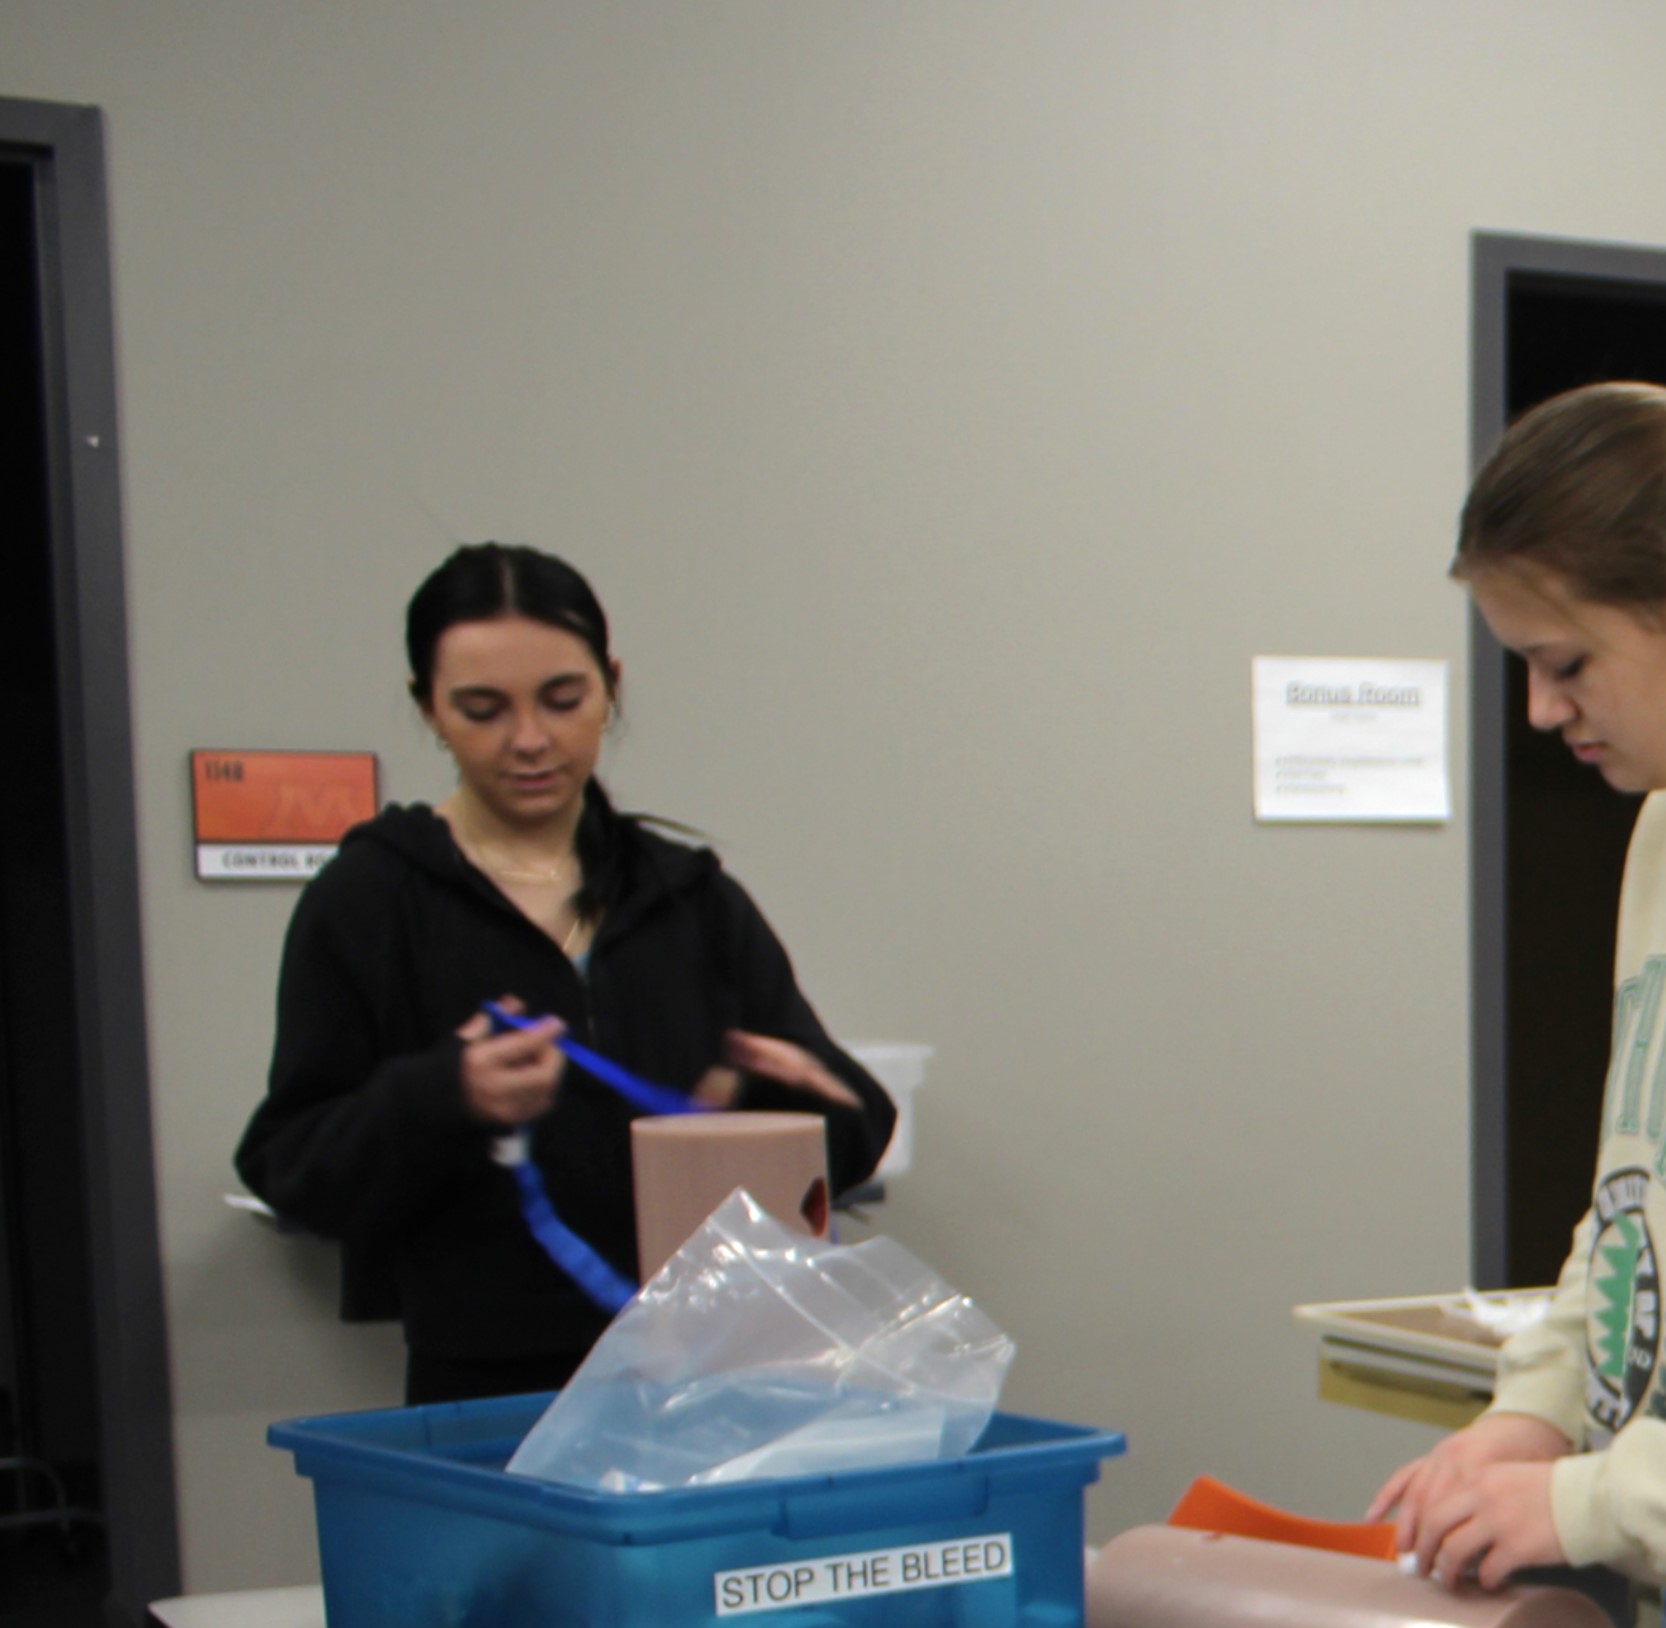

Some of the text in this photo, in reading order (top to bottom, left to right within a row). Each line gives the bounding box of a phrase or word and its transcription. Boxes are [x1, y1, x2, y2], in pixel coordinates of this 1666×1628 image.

[1285, 681, 1422, 707] Bonus Room
[222, 853, 298, 868] CONTROL
[722, 1541, 1006, 1609] STOP THE BLEED
